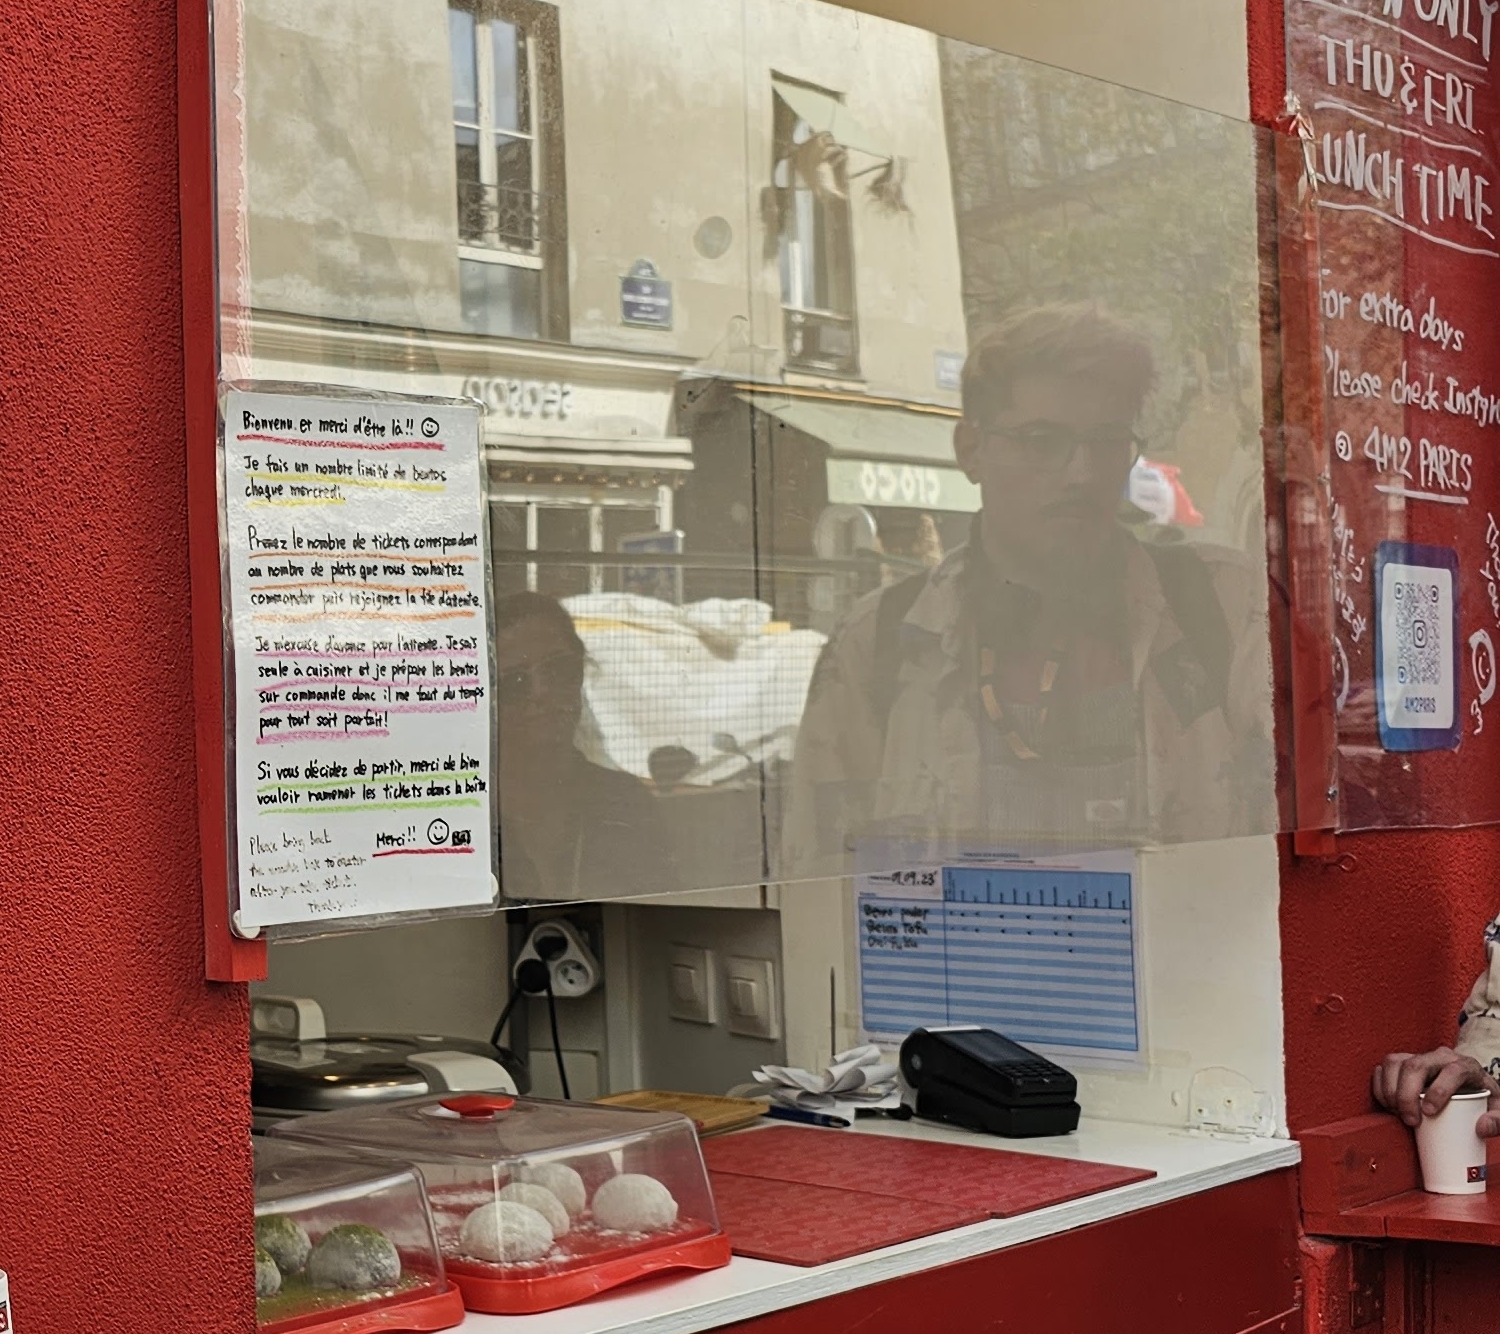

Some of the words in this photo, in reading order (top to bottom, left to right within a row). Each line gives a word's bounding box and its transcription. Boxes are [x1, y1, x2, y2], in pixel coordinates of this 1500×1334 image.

[1319, 34, 1395, 98] THU
[1412, 164, 1495, 240] TIME
[1360, 291, 1414, 333] extra
[1419, 296, 1464, 351] days
[1391, 360, 1440, 411] check
[319, 419, 348, 434] merci
[244, 455, 259, 471] Je
[266, 455, 289, 473] fais
[294, 461, 308, 472] un
[315, 459, 353, 476] nombre
[1419, 437, 1472, 491] PARIS
[245, 477, 283, 502] chaque
[353, 532, 366, 550] de
[311, 562, 323, 577] de
[383, 563, 406, 576] vous
[258, 661, 288, 678] seule
[294, 662, 304, 676] à
[306, 663, 352, 676] cuisiner
[372, 664, 386, 681] je
[432, 660, 444, 677] les
[259, 689, 279, 703] sur
[286, 684, 346, 701] commande
[352, 686, 376, 701] donc
[396, 689, 410, 701] me
[443, 685, 455, 700] du
[288, 711, 310, 728] tout
[316, 713, 337, 727] soit
[257, 761, 270, 780] Si
[276, 765, 300, 779] vous
[354, 759, 367, 775] de
[410, 758, 439, 774] merci
[443, 755, 455, 771] de
[460, 753, 479, 770] bien
[257, 787, 300, 805] vouloir
[363, 784, 376, 800] les
[383, 782, 422, 799] tickets
[426, 781, 451, 797] dans
